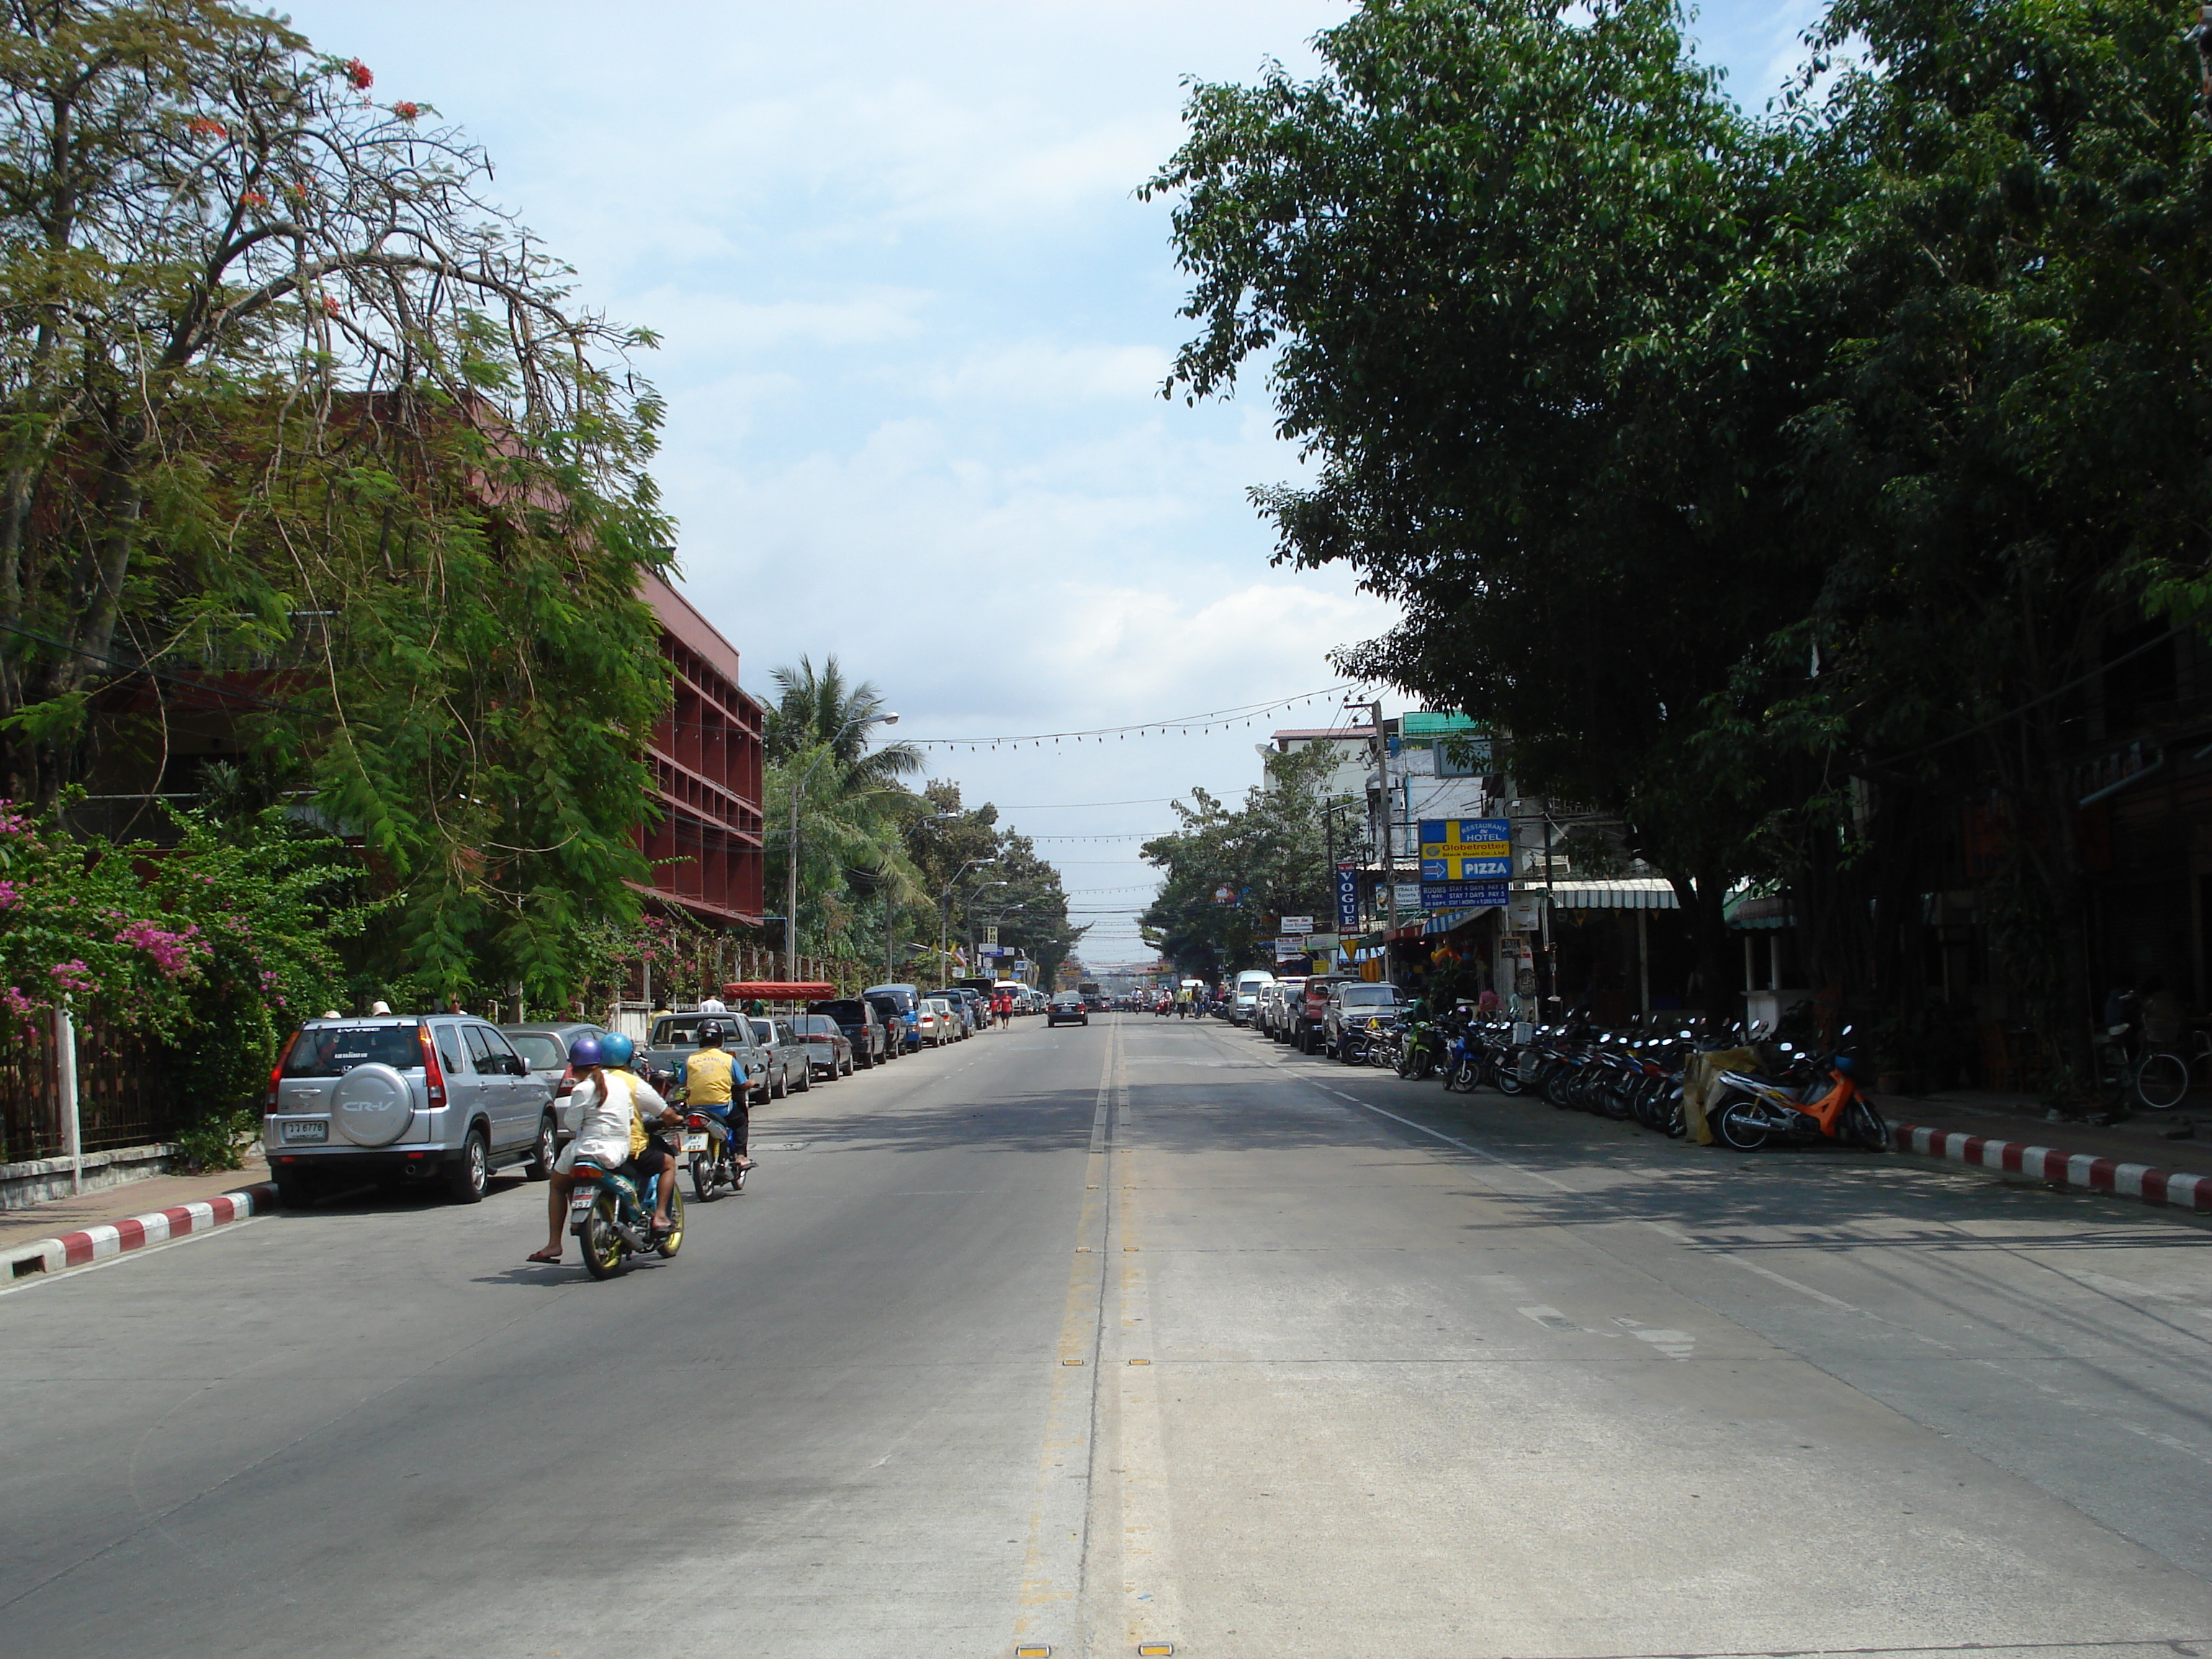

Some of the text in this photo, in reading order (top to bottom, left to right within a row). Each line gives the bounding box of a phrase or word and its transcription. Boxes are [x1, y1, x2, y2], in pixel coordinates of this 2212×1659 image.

[1461, 823, 1506, 834] RESTAURANT
[1465, 863, 1507, 875] PIZZA
[1340, 872, 1355, 925] VOGUE
[342, 1101, 395, 1112] CR-V
[303, 1123, 323, 1132] 6776
